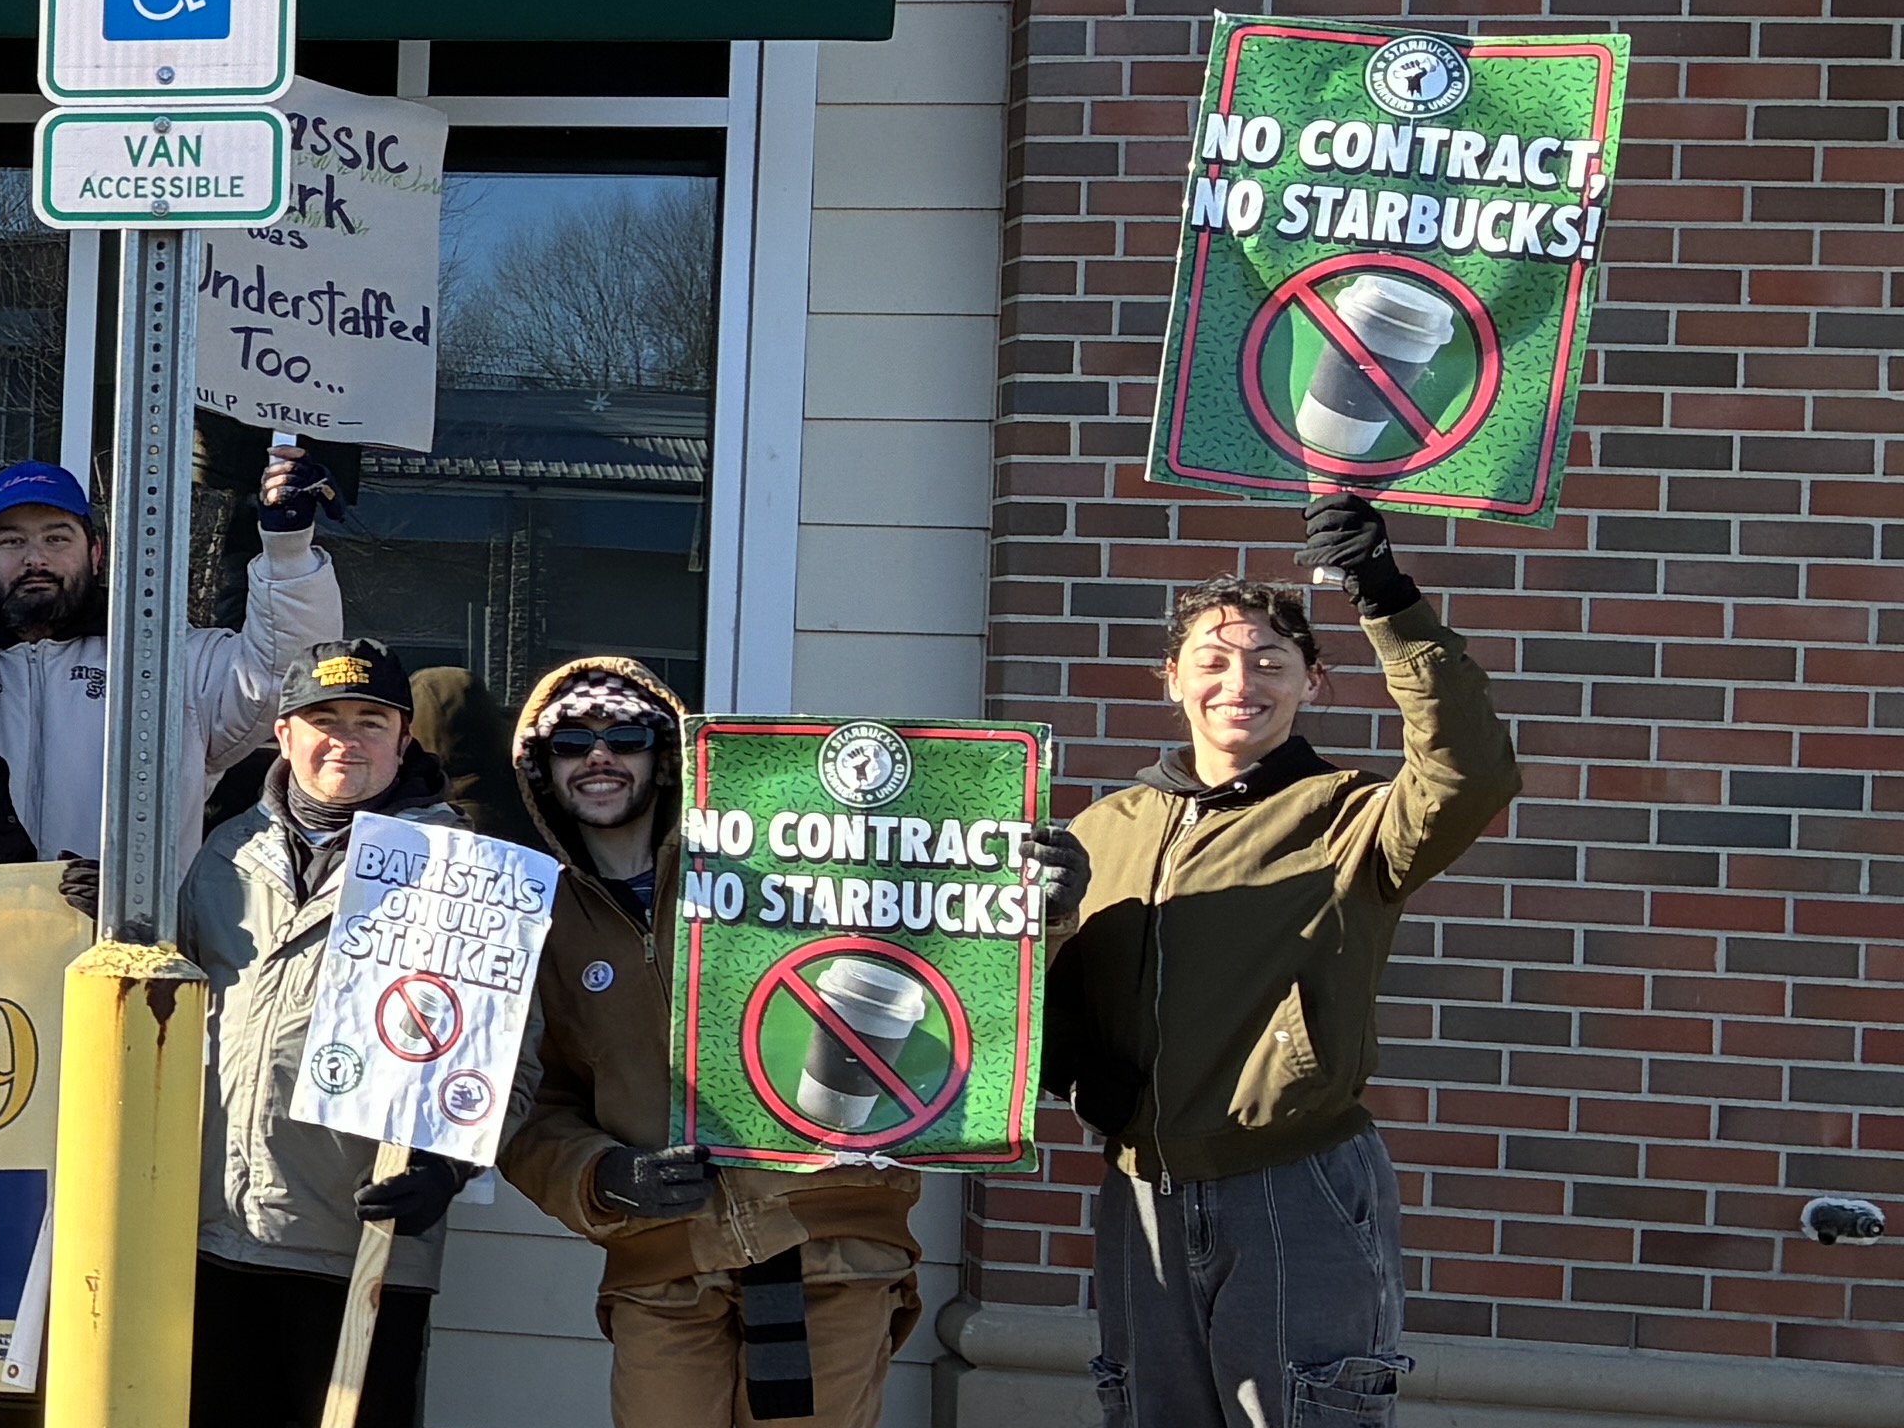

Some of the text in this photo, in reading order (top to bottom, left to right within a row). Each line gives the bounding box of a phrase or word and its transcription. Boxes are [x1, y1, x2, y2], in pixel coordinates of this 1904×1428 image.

[1384, 40, 1458, 69] STARBUCKS
[124, 134, 203, 169] VAN
[1201, 114, 1608, 199] NO CONTRACT,
[78, 175, 245, 200] ACCESSIBLE
[288, 174, 356, 235] rk
[1191, 176, 1604, 263] NO STARBUCKS!
[256, 401, 331, 429] STRIKE
[830, 726, 900, 752] STARBUCKS
[687, 808, 1041, 881] NO CONTRACT,
[355, 843, 546, 914] BARISTAS
[683, 871, 1043, 939] NO STARBUCKS!
[380, 887, 507, 940] ON ULP
[340, 914, 530, 994] STRIKE!
